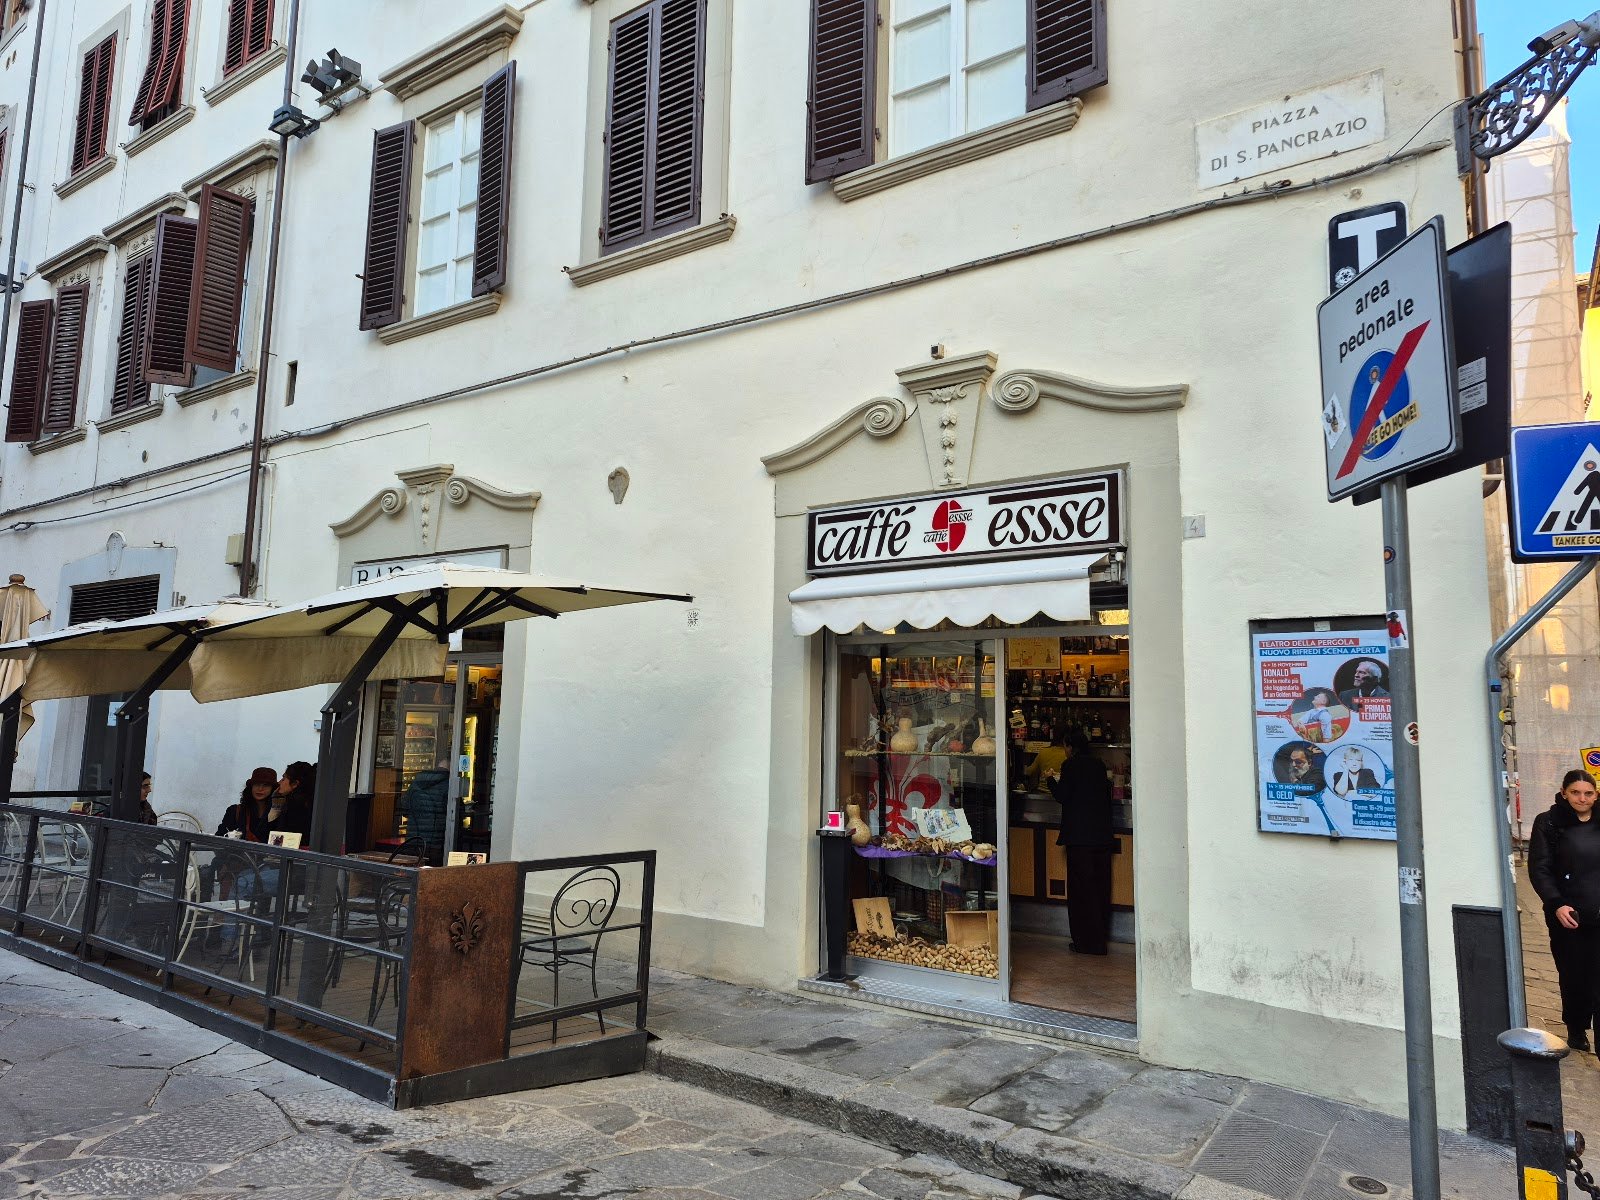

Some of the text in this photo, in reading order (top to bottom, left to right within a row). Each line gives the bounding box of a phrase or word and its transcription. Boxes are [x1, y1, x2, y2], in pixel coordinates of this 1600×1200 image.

[1252, 105, 1320, 134] PIAZZA
[1211, 117, 1367, 172] DI S. PANCRAZIO
[1355, 279, 1390, 316] area
[1339, 297, 1414, 363] pedonale
[1379, 422, 1391, 439] GO
[1391, 403, 1418, 432] HOME!
[817, 497, 1106, 563] caffé essse
[1189, 519, 1199, 533] 4
[1554, 536, 1586, 545] YANKEE
[1261, 638, 1355, 648] TEATRO DELLA PERGOLA
[1322, 647, 1348, 655] SCENA
[1350, 646, 1381, 654] APERTA
[1263, 669, 1289, 677] DONALD
[1364, 704, 1384, 712] PRIMA
[1360, 712, 1392, 720] TEMPORA
[1268, 790, 1293, 800] IL GELO
